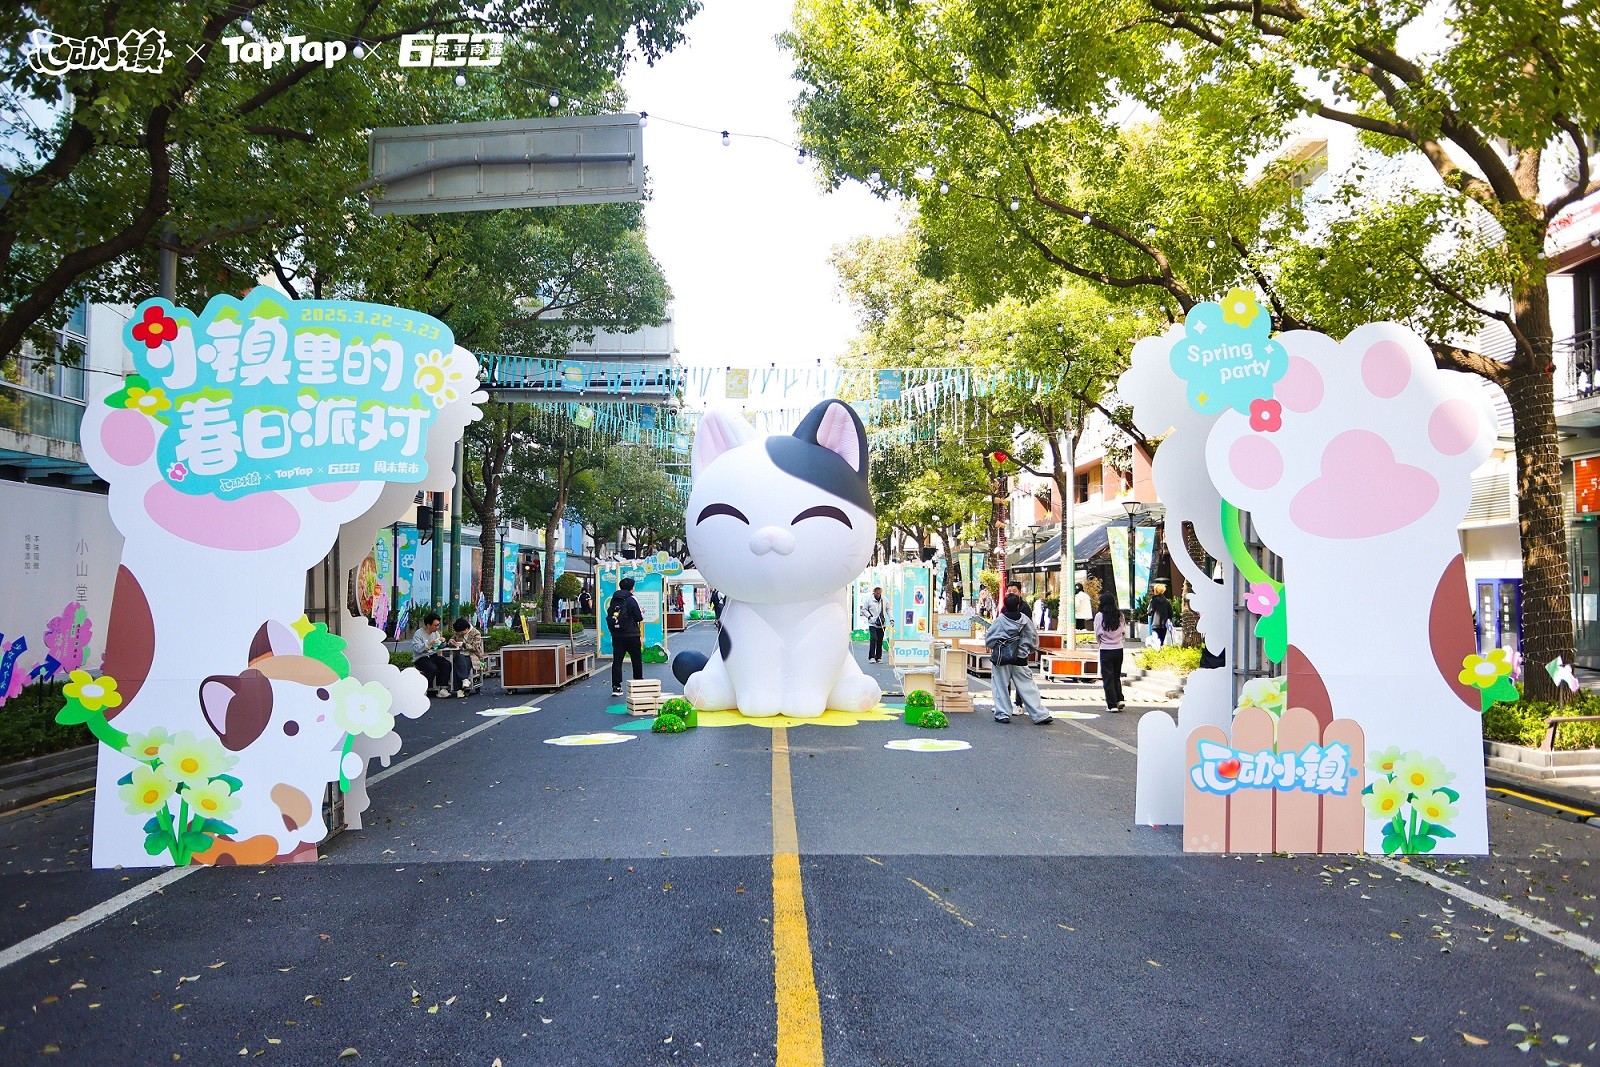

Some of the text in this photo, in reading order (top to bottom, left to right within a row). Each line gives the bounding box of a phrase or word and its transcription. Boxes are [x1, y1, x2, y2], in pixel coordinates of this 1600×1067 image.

[300, 307, 442, 341] 2025.3.22-3.23
[146, 302, 404, 392] 小镇里的
[1186, 340, 1255, 366] Spring
[1219, 357, 1272, 385] party
[174, 387, 430, 475] 春日派对
[274, 466, 313, 479] TapTap
[75, 537, 89, 602] 小山堂
[893, 646, 930, 657] TapTap
[1190, 739, 1351, 796] 心动小镇
